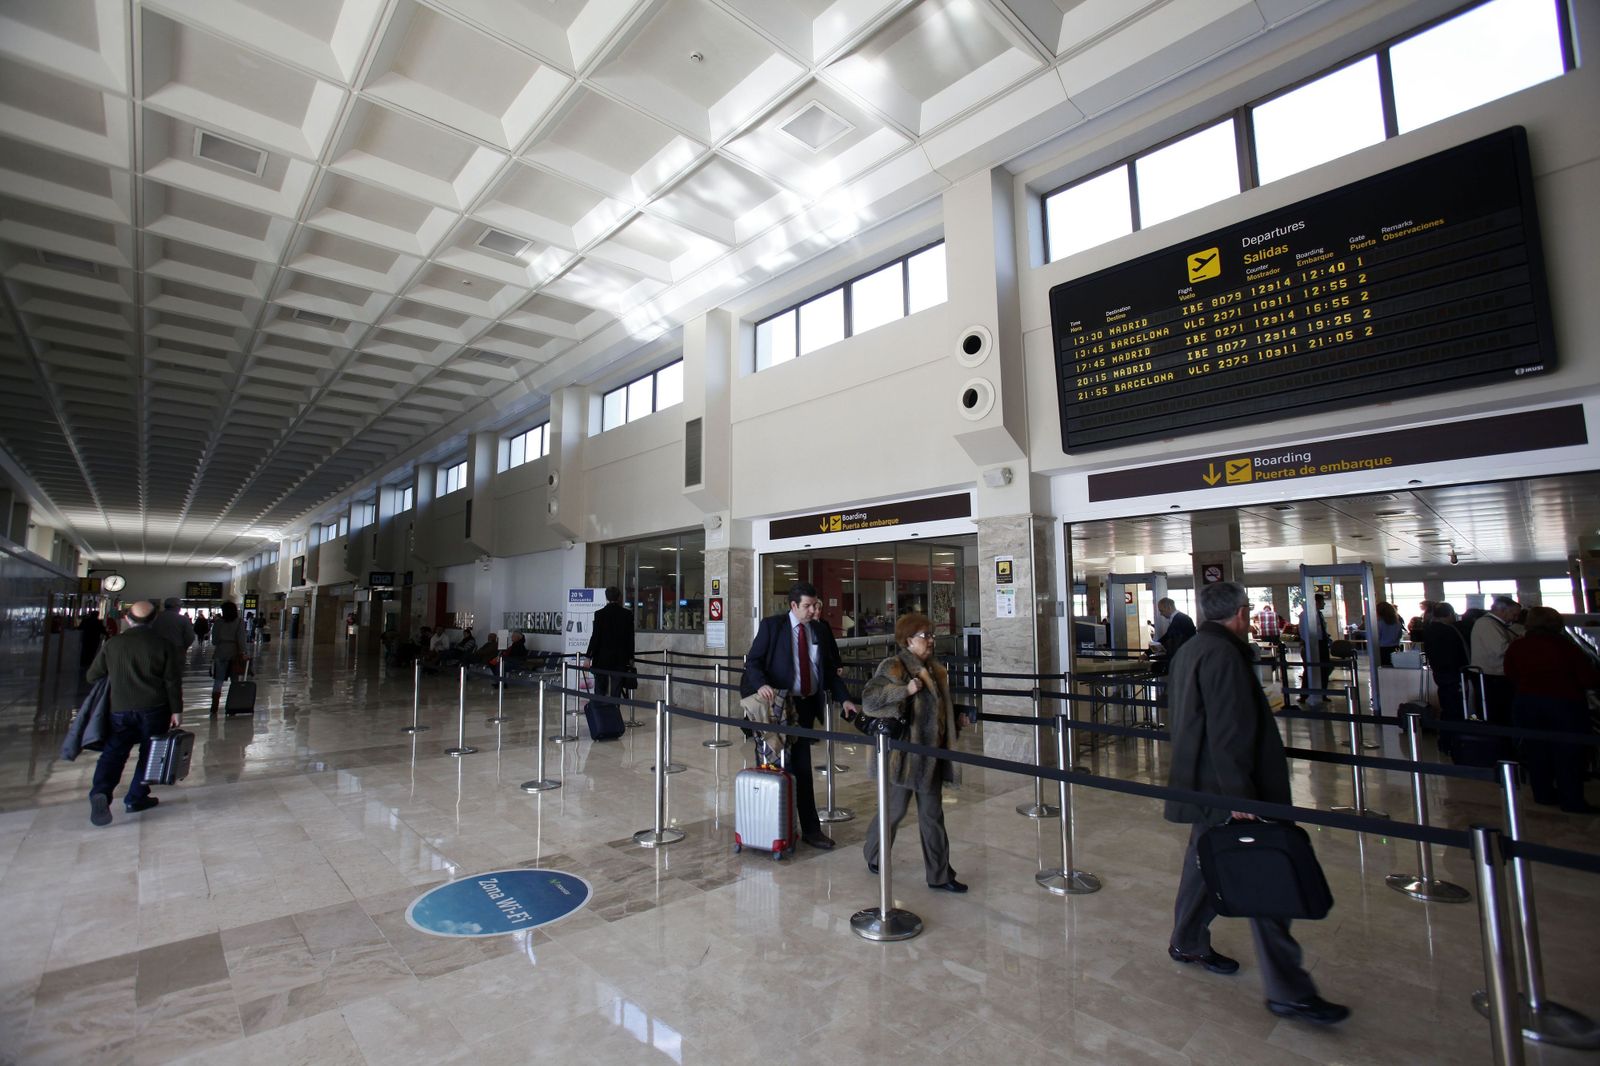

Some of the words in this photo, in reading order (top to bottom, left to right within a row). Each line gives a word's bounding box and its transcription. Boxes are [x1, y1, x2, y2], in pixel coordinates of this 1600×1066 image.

[1242, 221, 1306, 247] Departures
[1381, 220, 1413, 234] Remarks
[1383, 219, 1445, 241] Observaciones
[1349, 234, 1366, 244] Gate
[1350, 239, 1377, 251] Puerta
[1243, 244, 1289, 265] Salidas
[1296, 247, 1324, 260] Boarding
[1297, 252, 1334, 267] Embarque
[1246, 264, 1268, 274] Counter
[1247, 267, 1280, 281] Mostrador
[1074, 331, 1103, 345] 13:30
[1109, 319, 1148, 335] MADRID
[1182, 303, 1203, 315] IBE
[1212, 292, 1242, 307] 8079
[1302, 262, 1346, 282] 12:40
[1357, 257, 1363, 266] 1
[1075, 345, 1104, 358] 13:45
[1111, 328, 1169, 349] BARCELONA
[1184, 318, 1205, 329] VLG
[1214, 308, 1242, 322] 2371
[1304, 279, 1347, 298] 12:55
[1358, 274, 1367, 283] 2
[1076, 359, 1105, 372] 17:45
[1112, 347, 1151, 363] MADRID
[1186, 333, 1207, 345] IBE
[1215, 323, 1244, 337] 0271
[1306, 296, 1350, 315] 16:55
[1360, 291, 1369, 301] 2
[1077, 373, 1107, 386] 20:15
[1113, 362, 1152, 378] MADRID
[1187, 348, 1208, 360] IBE
[1217, 339, 1247, 353] 8077
[1308, 313, 1352, 332] 19:25
[1362, 309, 1371, 318] 2
[1078, 387, 1108, 400] 21:55
[1115, 372, 1174, 392] BARCELONA
[1189, 364, 1210, 375] VLG
[1218, 355, 1249, 369] 2373
[1309, 330, 1354, 349] 21:05
[1365, 326, 1373, 336] 2
[1254, 452, 1312, 467] Boarding
[1255, 468, 1296, 481] Puerta
[1300, 465, 1316, 475] de
[1320, 456, 1393, 473] embarque
[842, 512, 867, 521] Boarding
[843, 522, 860, 530] Puerta
[861, 520, 869, 528] de
[870, 518, 899, 527] embarque
[478, 878, 505, 900] Zona
[496, 897, 533, 924] Wi-Fi
